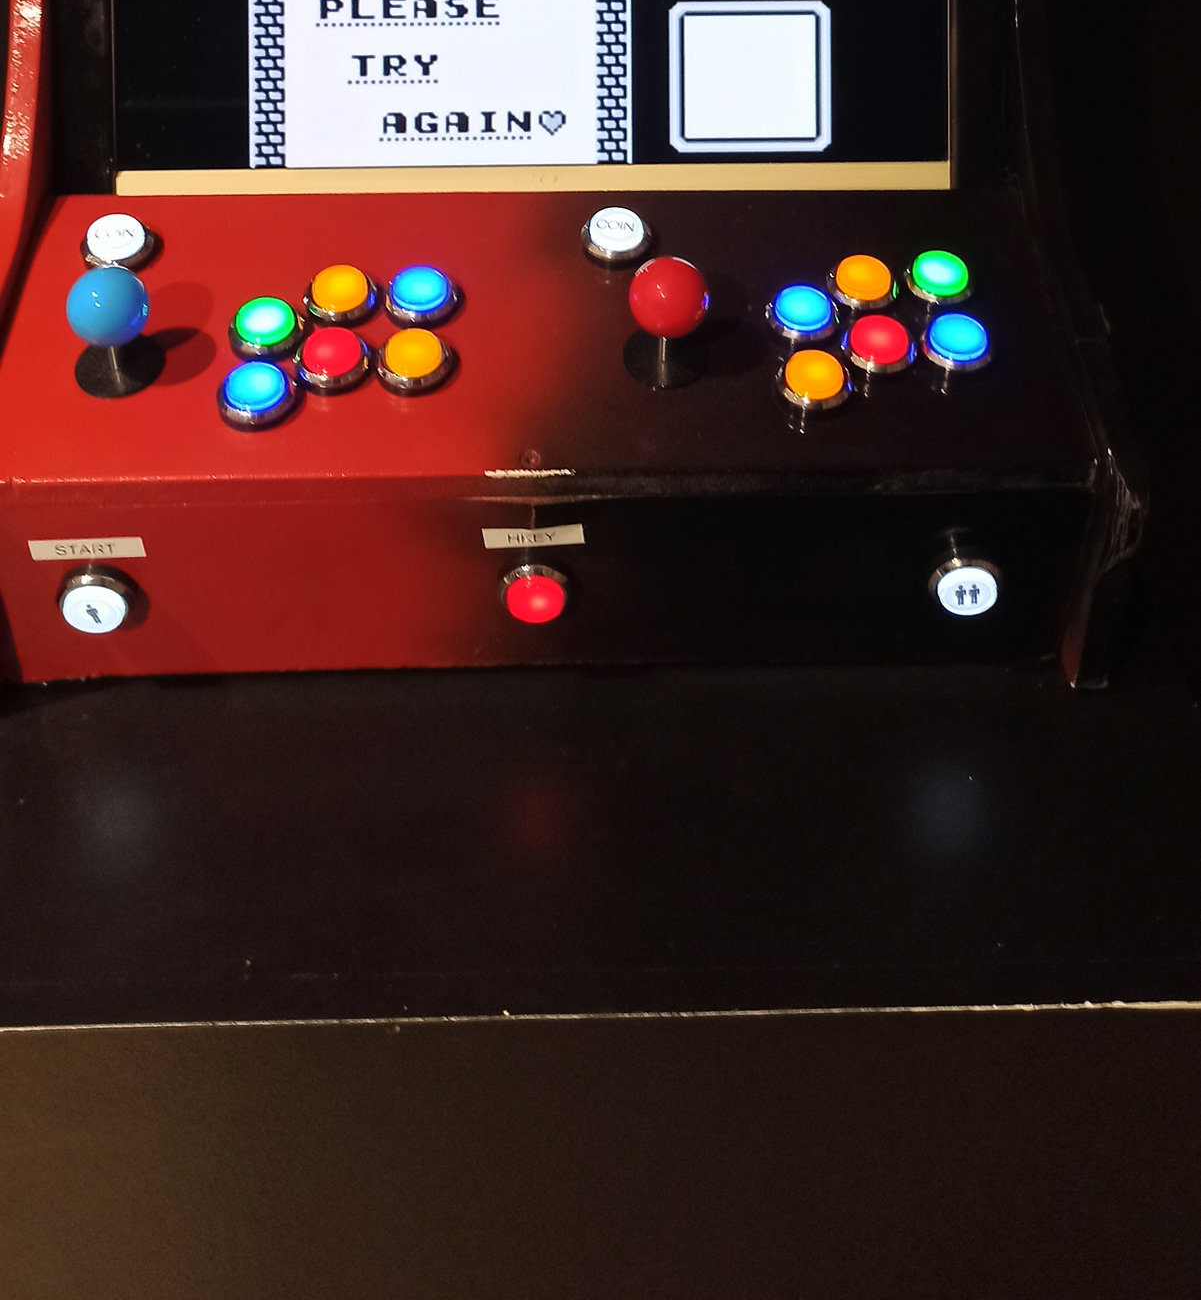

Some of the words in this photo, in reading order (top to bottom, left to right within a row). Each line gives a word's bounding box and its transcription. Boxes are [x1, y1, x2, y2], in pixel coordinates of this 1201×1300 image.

[351, 54, 438, 77] TRY
[382, 111, 532, 134] AGAIN
[596, 219, 635, 232] COIN
[54, 543, 116, 556] START
